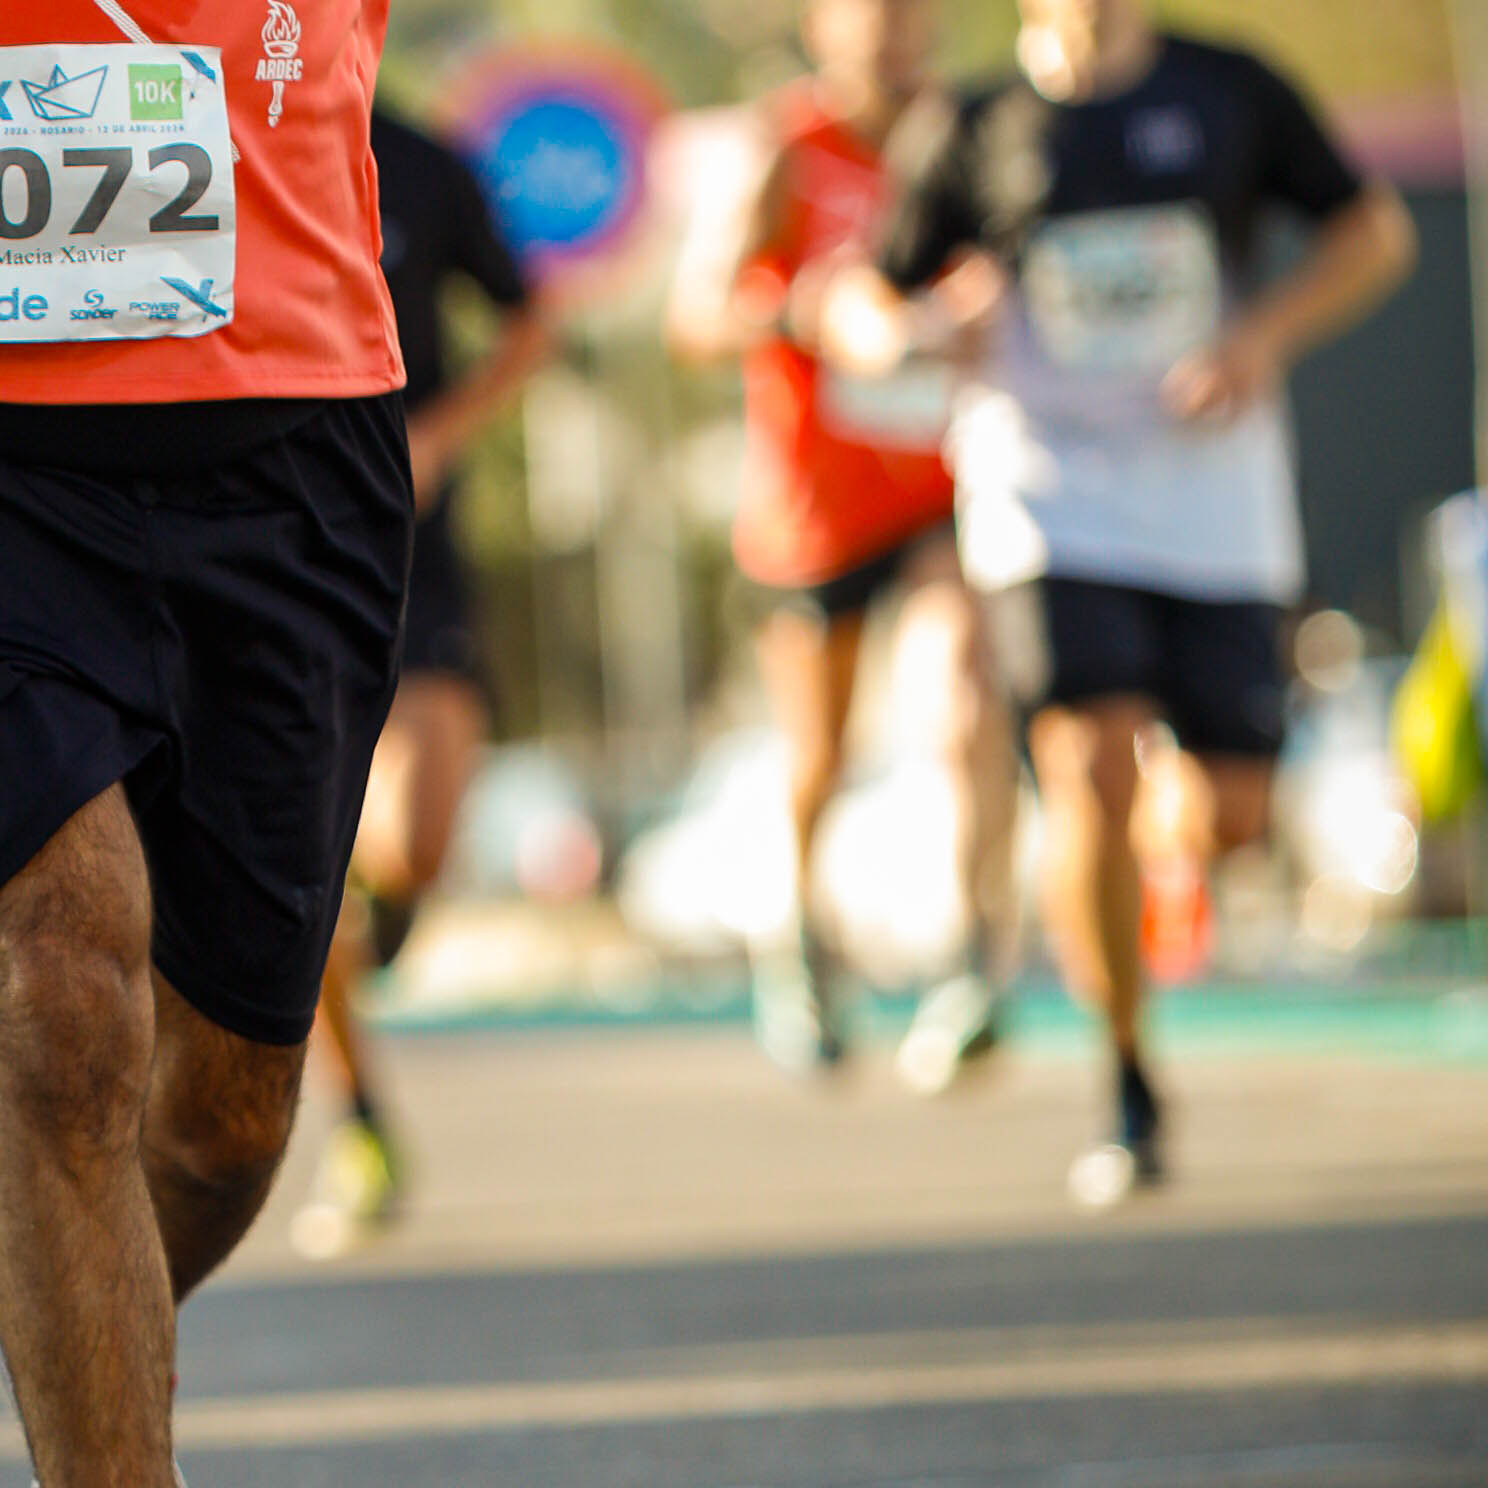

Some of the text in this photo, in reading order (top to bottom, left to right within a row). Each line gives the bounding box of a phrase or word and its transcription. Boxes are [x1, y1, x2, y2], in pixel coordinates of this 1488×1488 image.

[255, 58, 303, 81] ARDEC
[134, 80, 177, 104] 10K
[39, 125, 85, 135] ROSARIO
[59, 244, 127, 264] Xavier
[128, 301, 181, 312] POWER
